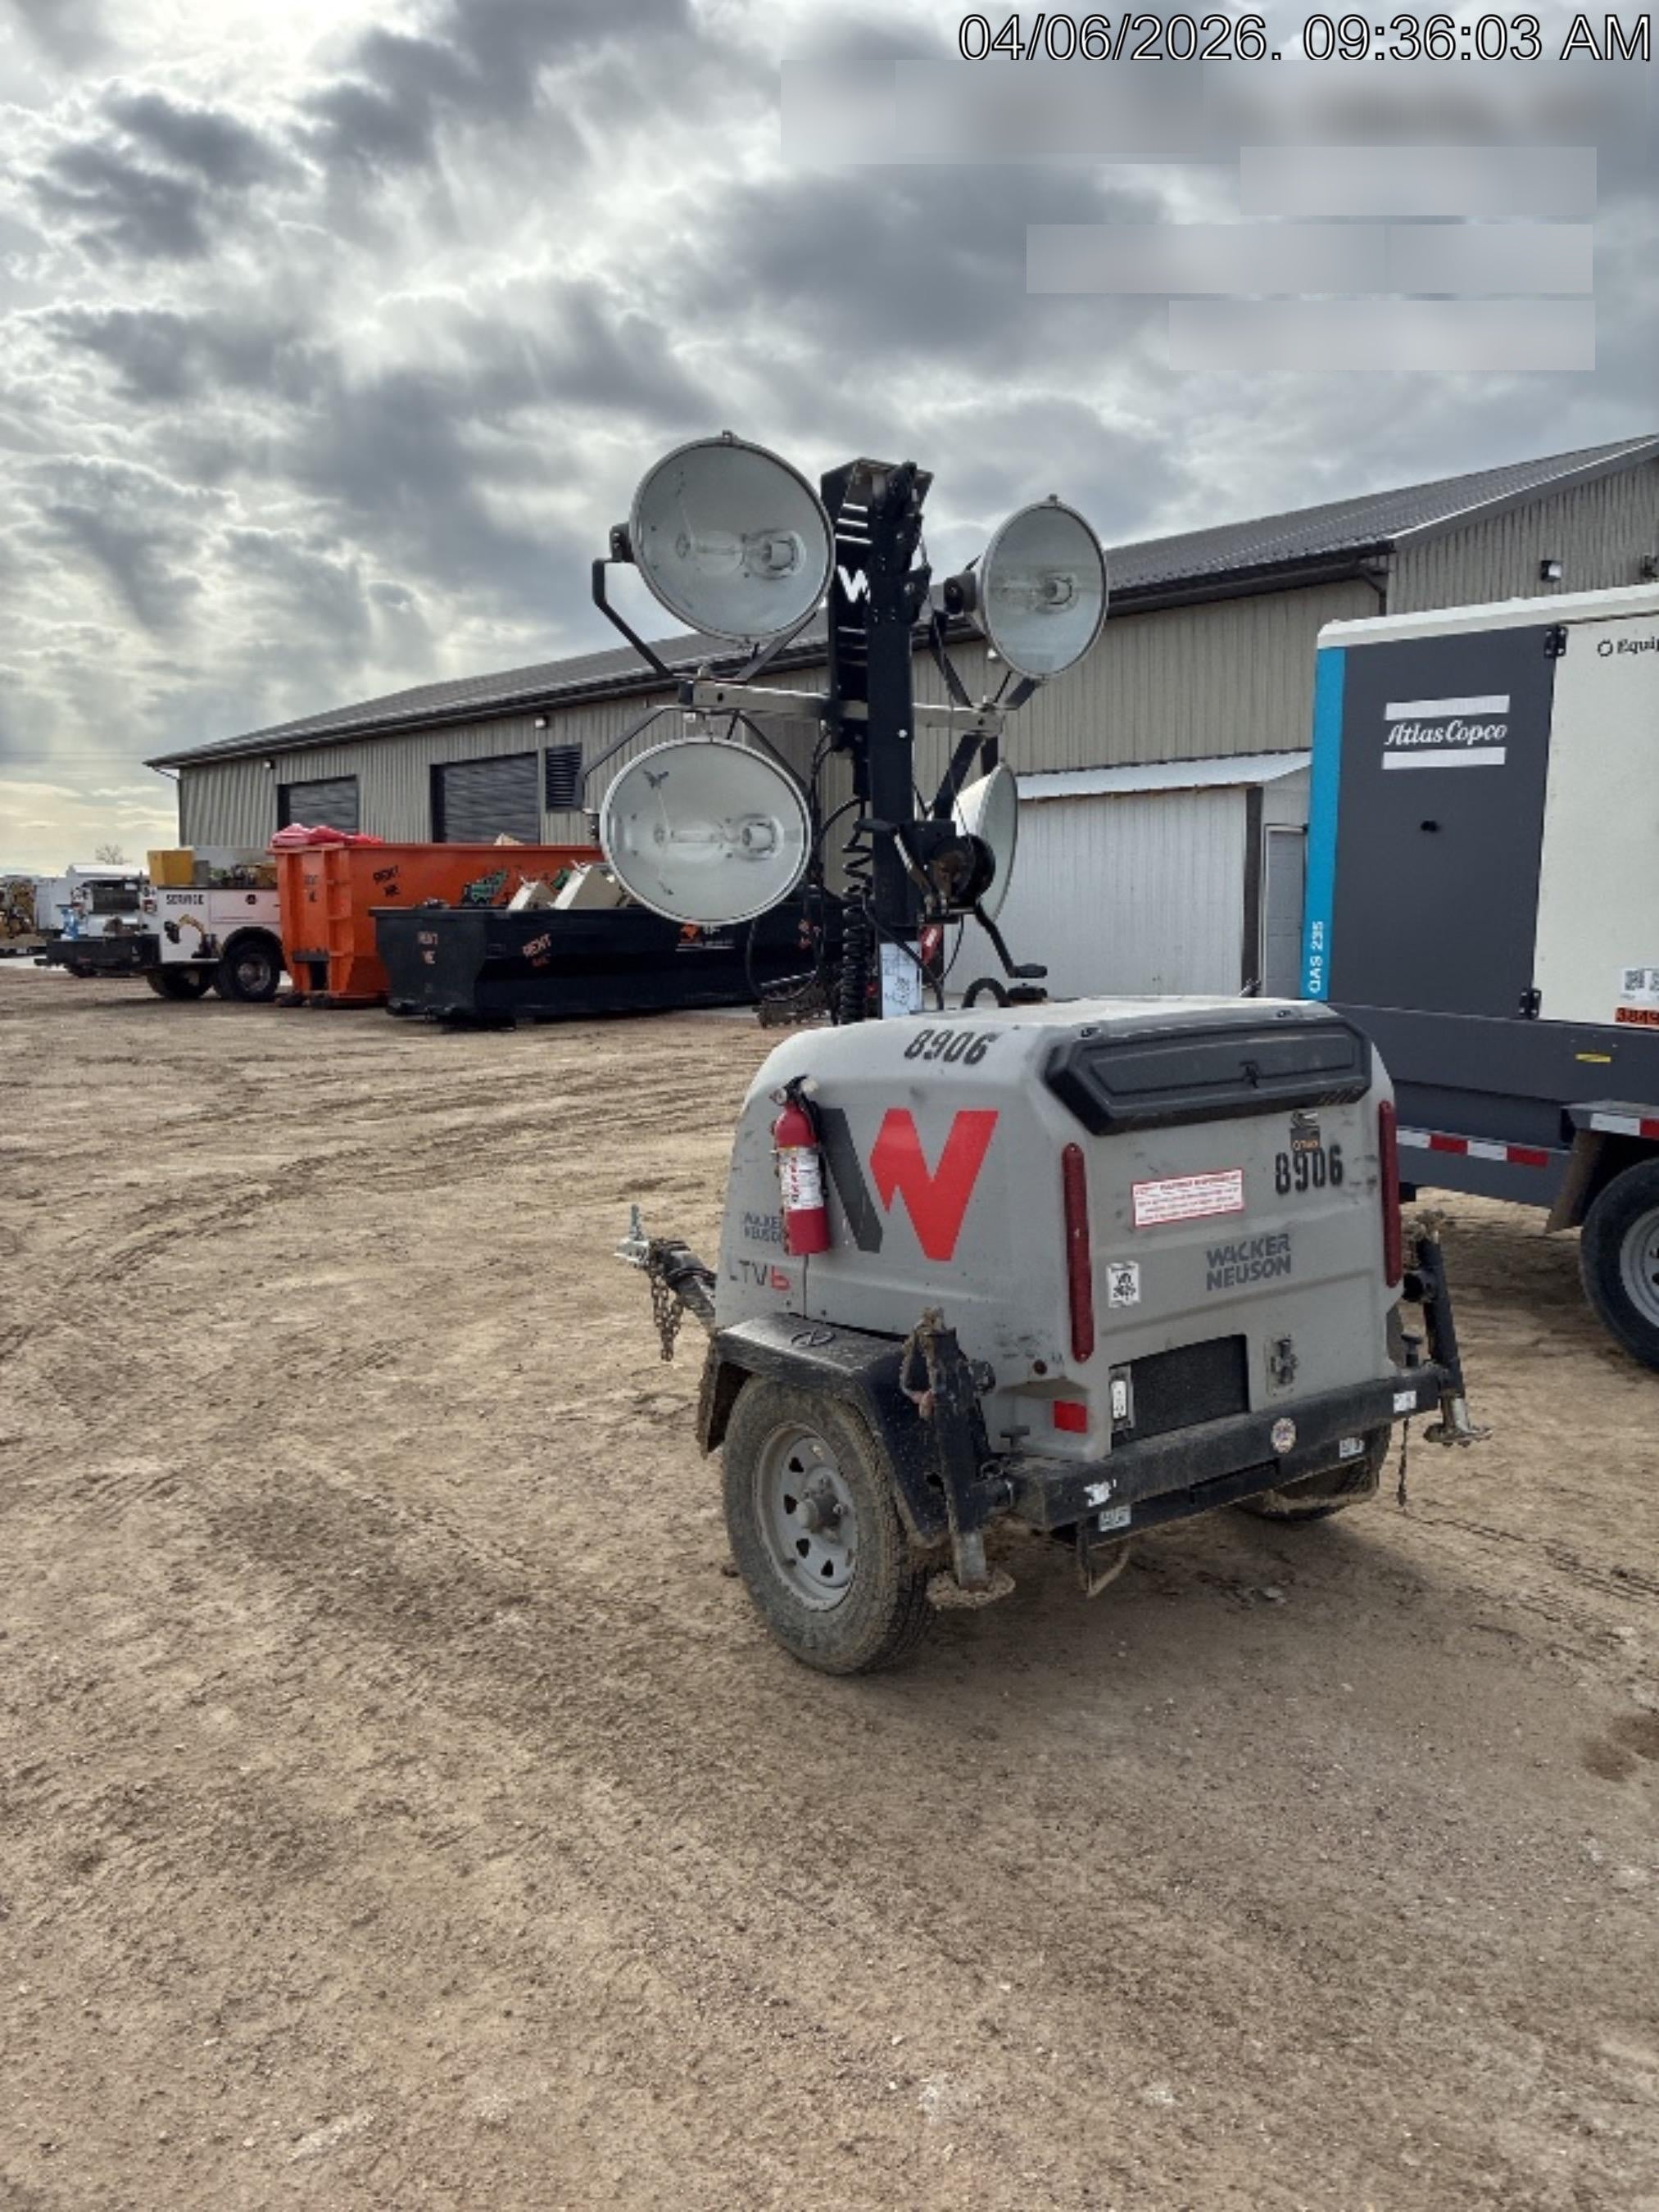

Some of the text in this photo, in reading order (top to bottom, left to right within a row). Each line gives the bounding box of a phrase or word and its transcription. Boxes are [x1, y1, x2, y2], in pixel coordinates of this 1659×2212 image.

[1384, 719, 1507, 745] Atlas Copco
[904, 1029, 998, 1065] 8906
[1276, 1145, 1344, 1195] 8906
[1206, 1233, 1291, 1269] WACKER
[1206, 1254, 1291, 1291] NEUSON
